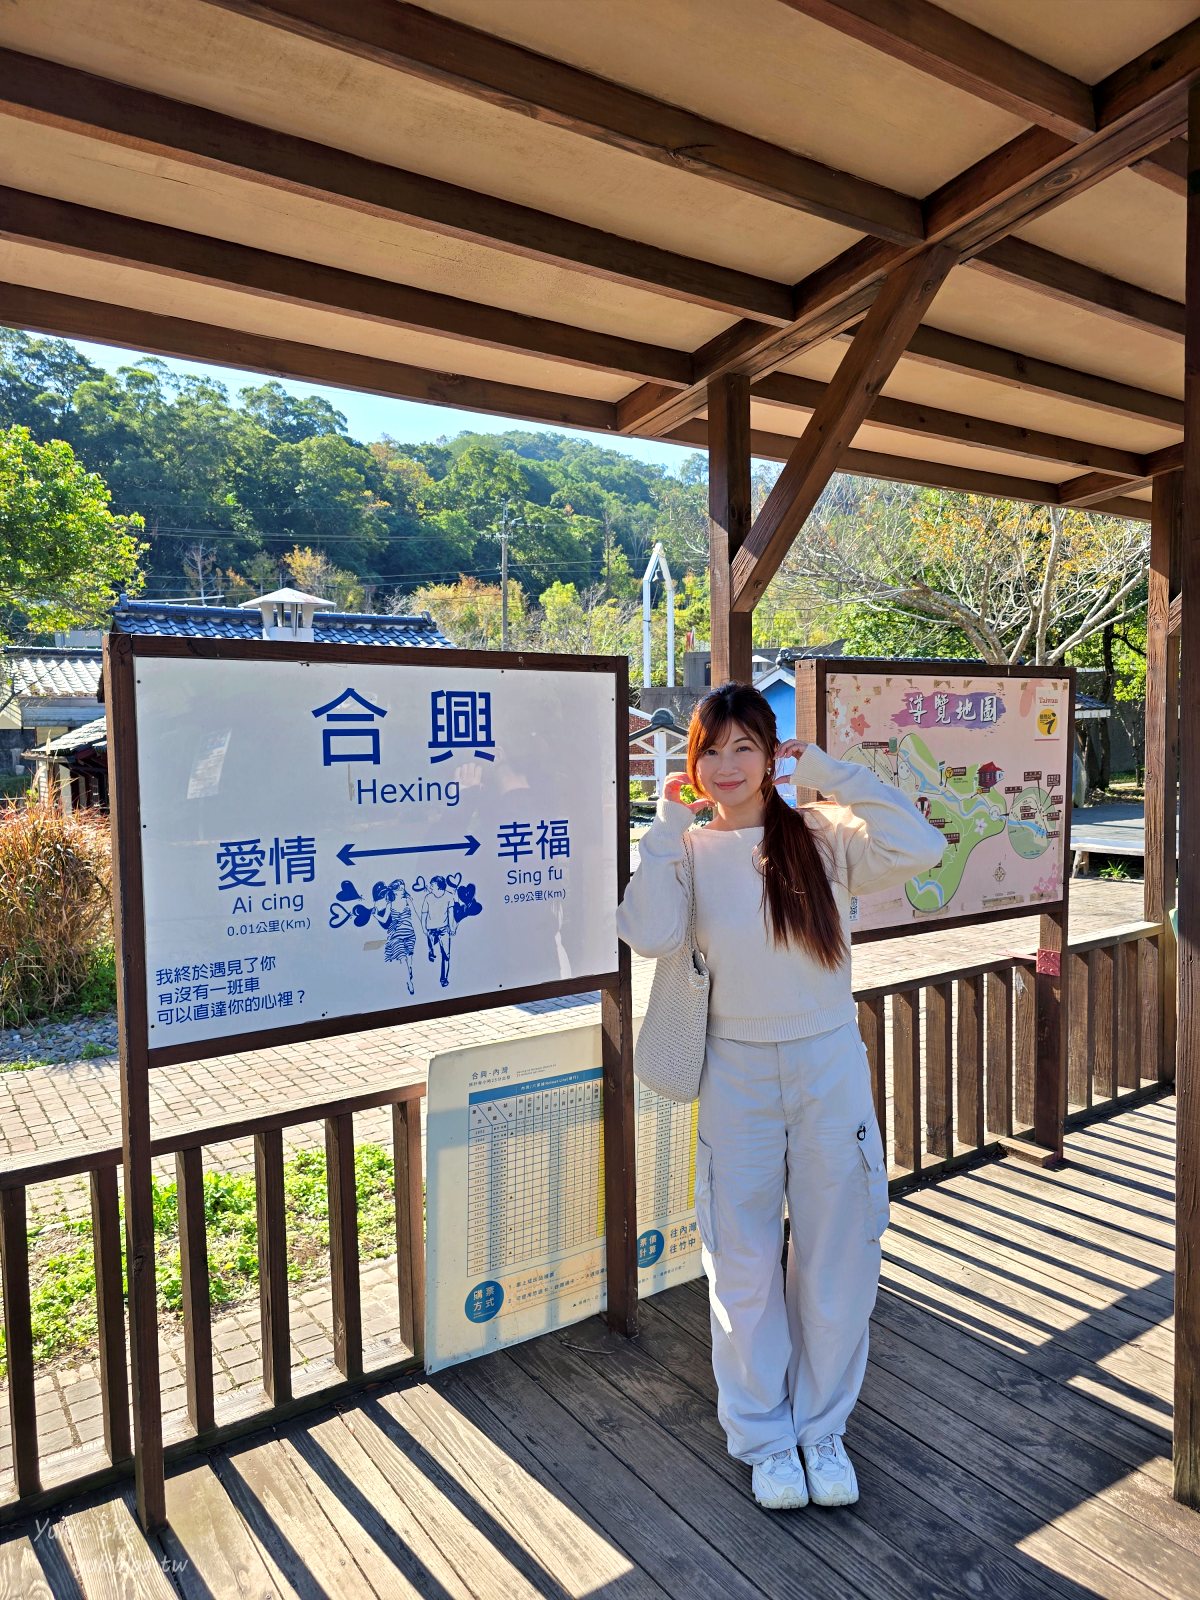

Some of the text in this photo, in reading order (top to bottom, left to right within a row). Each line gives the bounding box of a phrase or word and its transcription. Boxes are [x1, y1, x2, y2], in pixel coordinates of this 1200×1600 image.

[908, 693, 998, 724] 導覽地圖
[357, 777, 460, 807] Hexing
[496, 819, 570, 863] 幸福
[216, 835, 317, 891] 愛情
[506, 865, 563, 886] Sing fu
[232, 893, 304, 915] Ai cing
[504, 888, 567, 904] 9.99公里(Km)
[227, 917, 311, 937] 0.01公里(Km)
[155, 955, 277, 986] 我終於遇見了你
[669, 1237, 696, 1254] 往竹中
[473, 1298, 495, 1312] 方式
